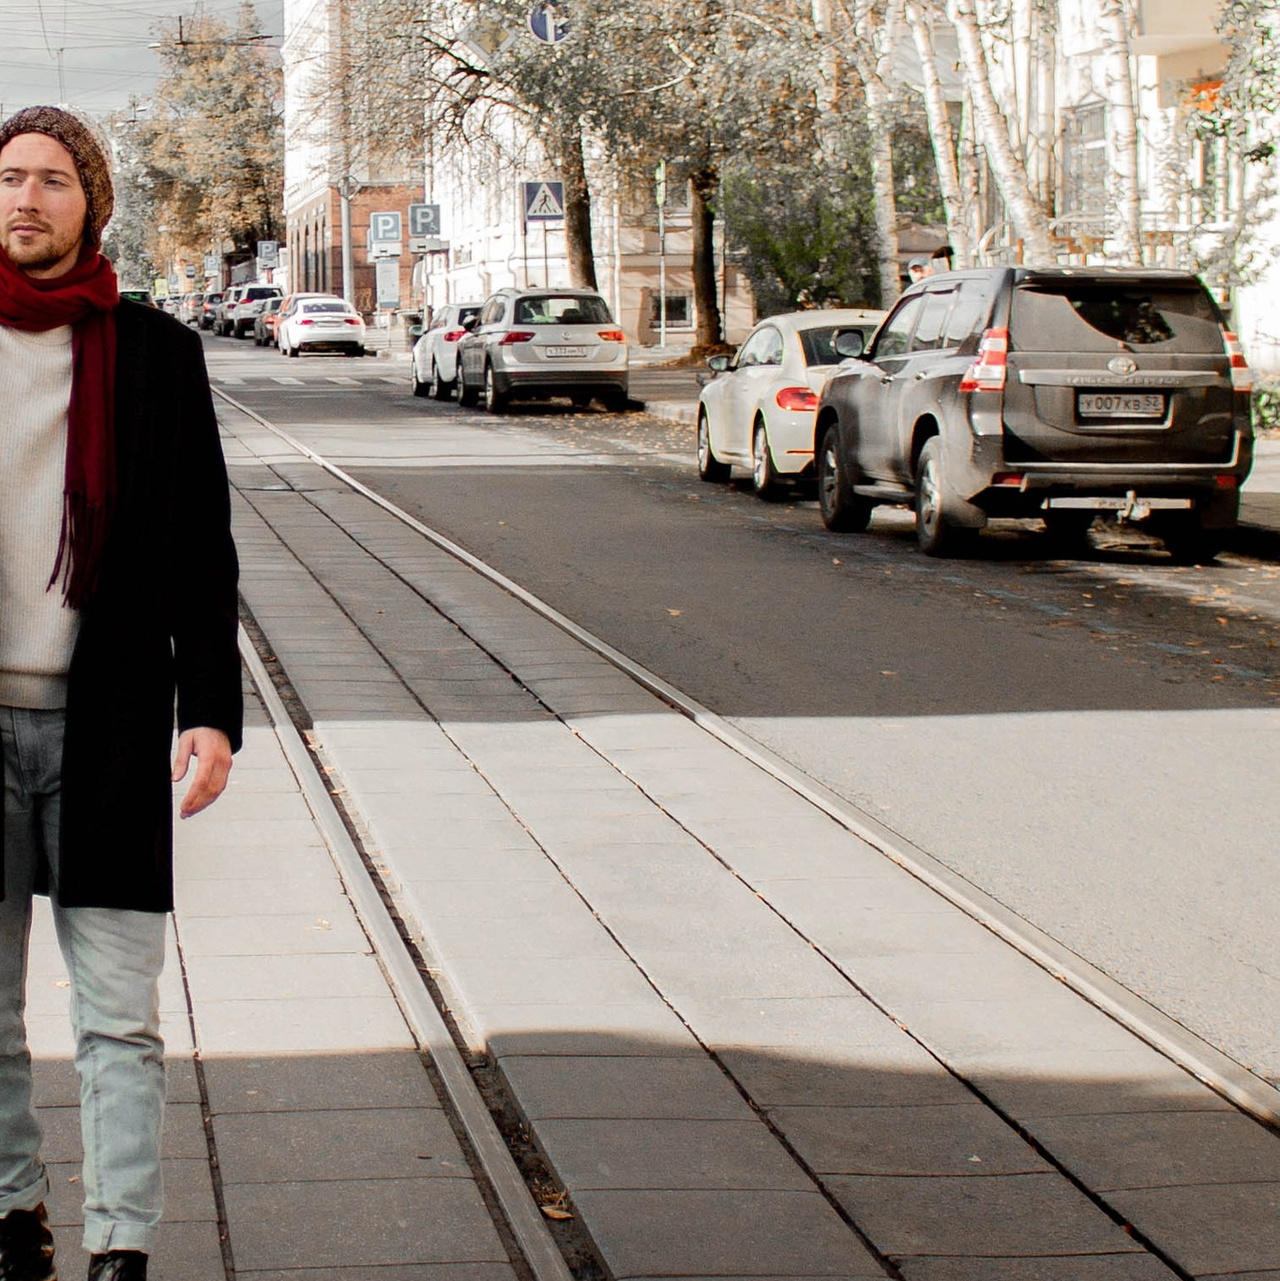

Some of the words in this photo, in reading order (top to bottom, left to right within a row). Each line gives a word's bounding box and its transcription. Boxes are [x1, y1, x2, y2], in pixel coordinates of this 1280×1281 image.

[377, 215, 394, 239] P
[416, 208, 434, 232] P
[263, 243, 272, 258] P
